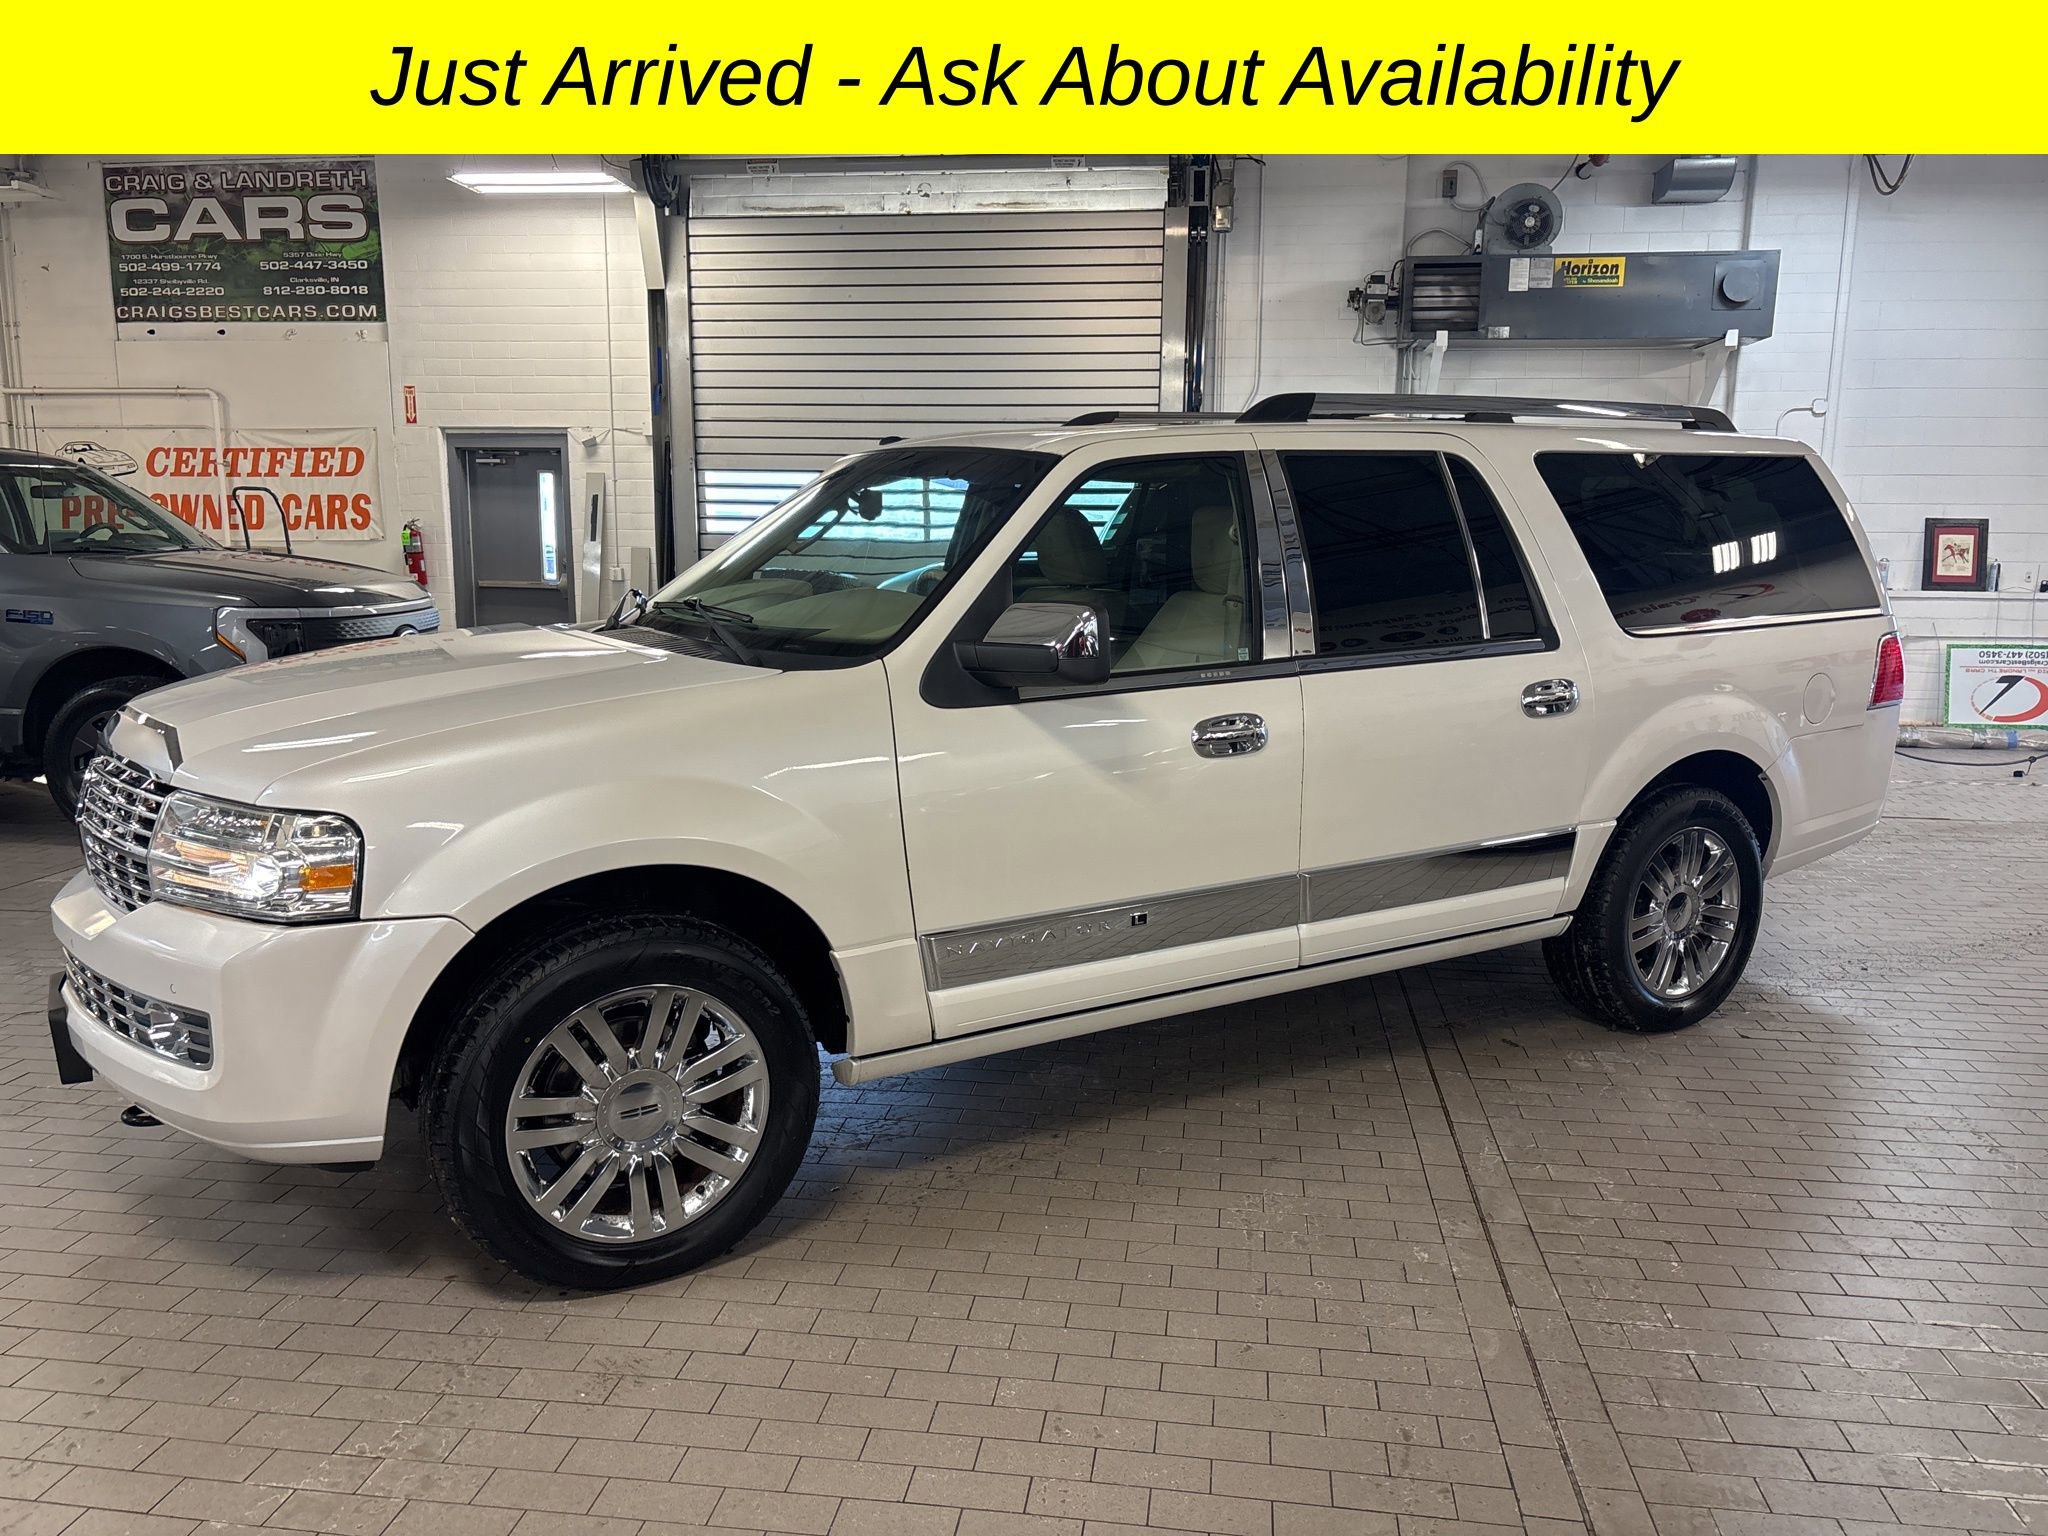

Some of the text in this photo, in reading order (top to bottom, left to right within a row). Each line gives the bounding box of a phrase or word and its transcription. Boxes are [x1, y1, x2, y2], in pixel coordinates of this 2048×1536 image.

[105, 170, 367, 192] CRAIG & LANDRETH
[110, 194, 369, 242] CARS
[119, 262, 222, 272] 502-499-1774
[260, 260, 368, 270] 502-447-3450
[1561, 258, 1620, 275] Horizon
[120, 287, 225, 297] 502-244-2220
[263, 285, 369, 295] 812-280-8018
[116, 304, 377, 319] CRAIGSBESTCARS.COM
[146, 446, 365, 478] CERTIFIED
[281, 492, 372, 530] CARS
[1979, 650, 2023, 659] 447-3450
[947, 921, 1112, 955] NAVIGATOR
